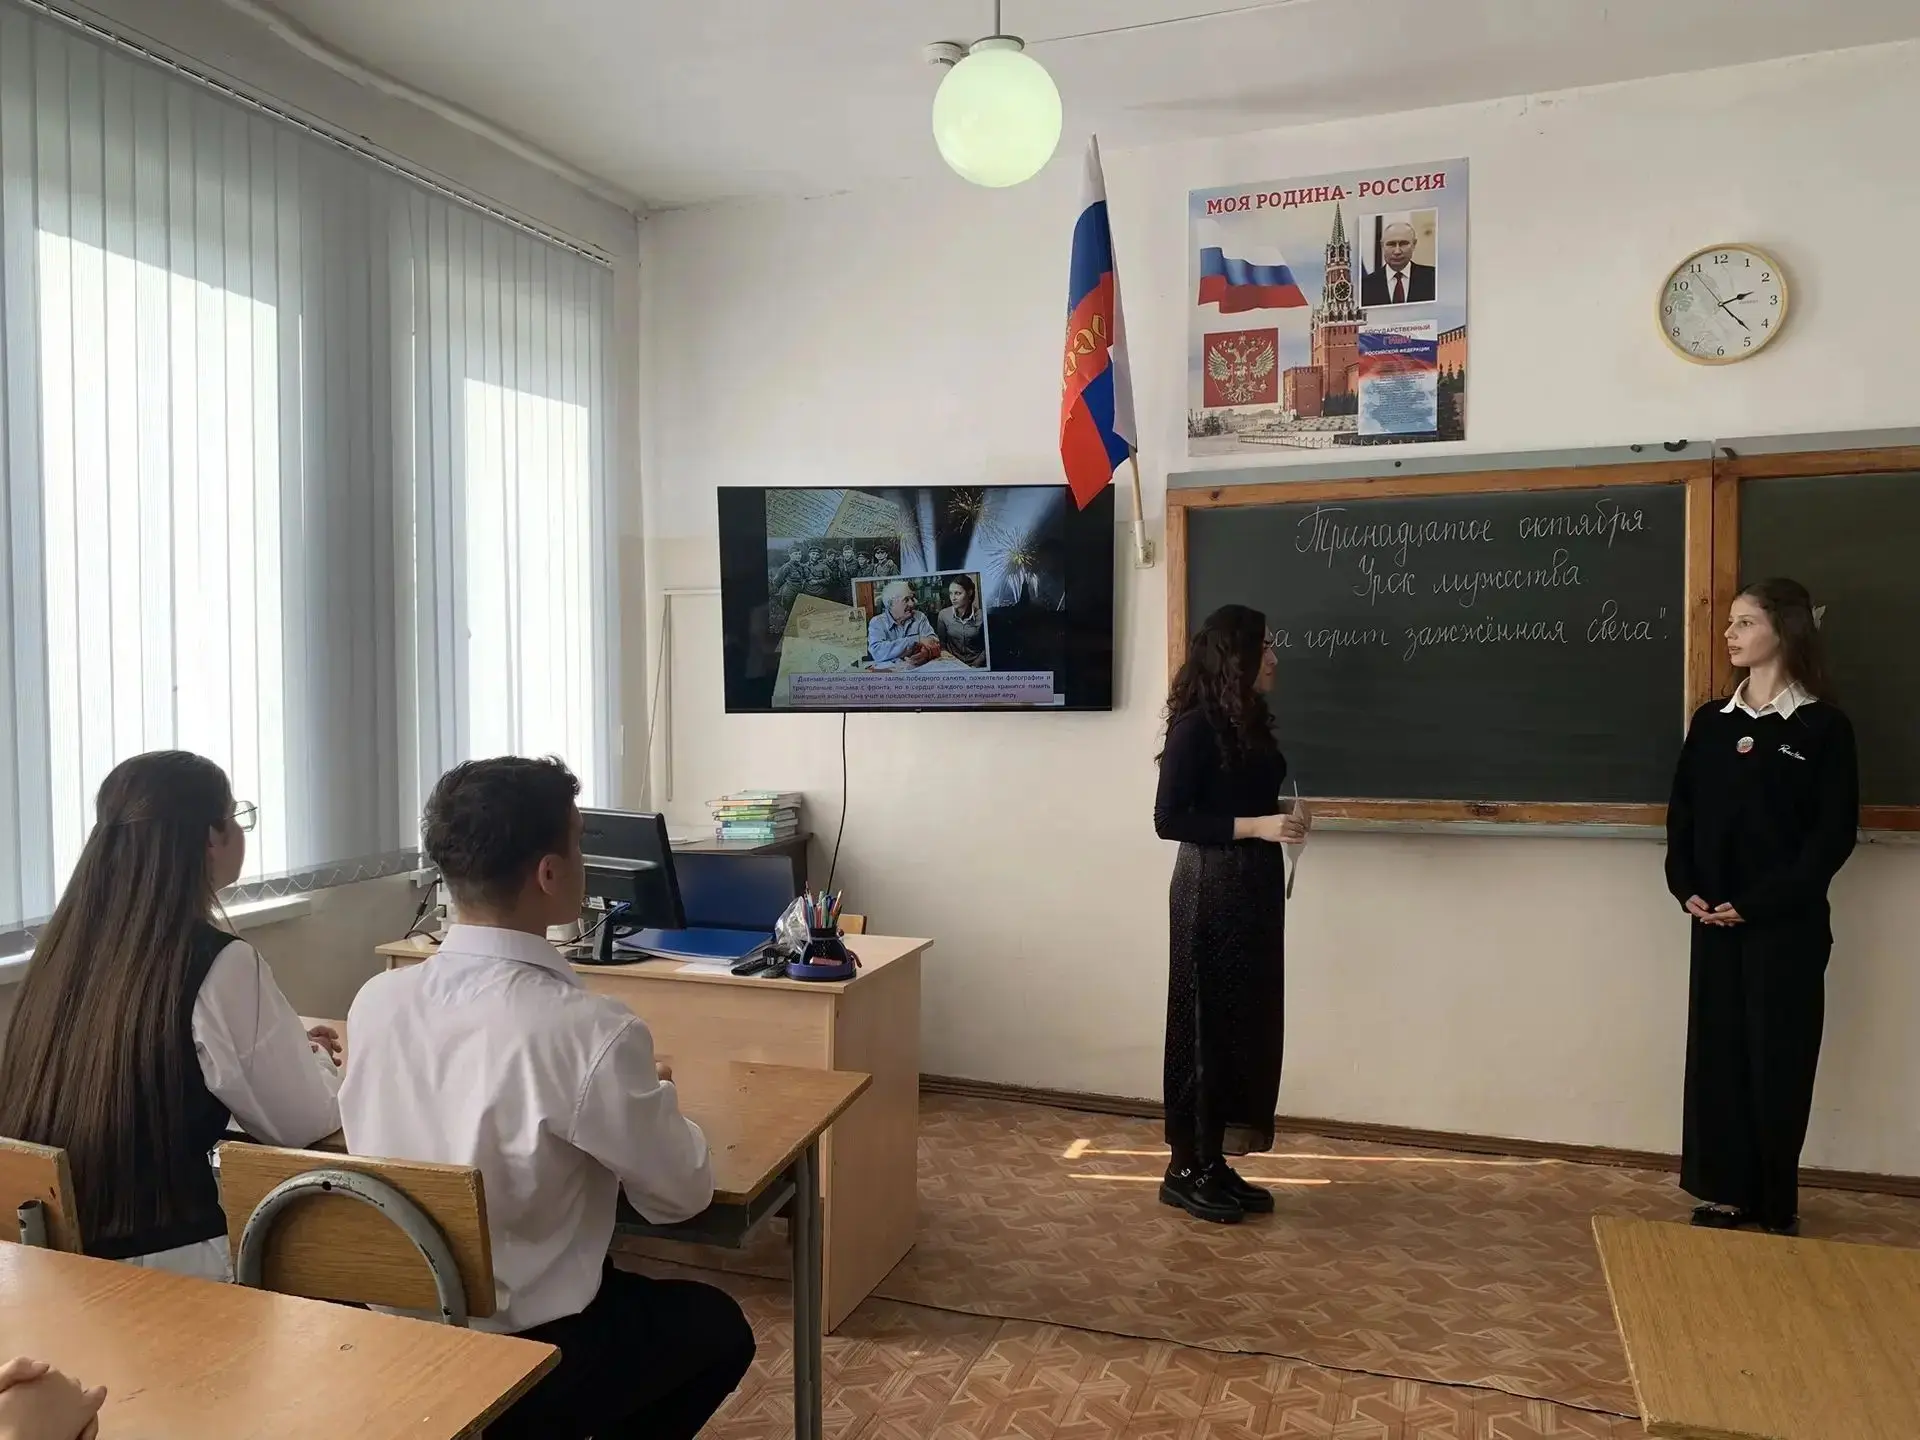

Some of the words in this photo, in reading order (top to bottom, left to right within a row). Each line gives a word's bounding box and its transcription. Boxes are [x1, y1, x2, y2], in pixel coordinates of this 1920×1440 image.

[1206, 195, 1251, 215] МОЯ
[1256, 185, 1352, 210] РОДИНА-
[1358, 173, 1446, 198] РОССИЯ
[1713, 254, 1729, 265] 12
[1744, 258, 1751, 268] 1
[1690, 263, 1702, 273] 11
[1761, 272, 1770, 283] 2
[1673, 281, 1689, 292] 10
[1769, 295, 1778, 306] 3
[1664, 305, 1673, 316] 9
[1761, 318, 1769, 329] 4
[1672, 327, 1681, 337] 8
[1692, 341, 1700, 352] 7
[1743, 336, 1751, 348] 5
[1716, 345, 1725, 356] 6
[1296, 505, 1494, 568] Тринадцатое
[1353, 554, 1416, 607] Урок
[1304, 627, 1390, 658] горит
[1403, 615, 1568, 662] зажжённая
